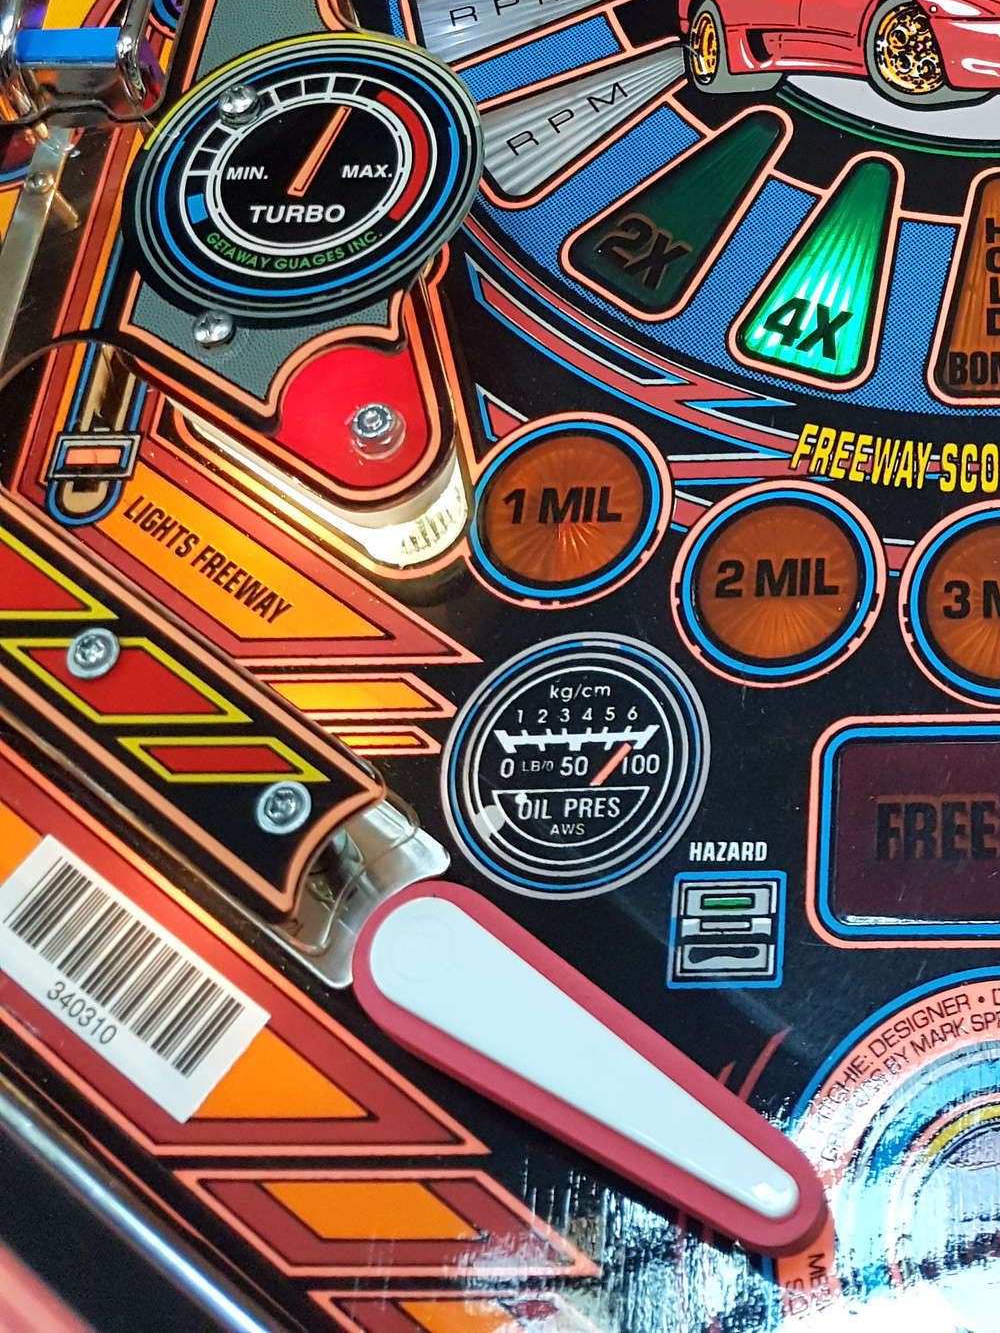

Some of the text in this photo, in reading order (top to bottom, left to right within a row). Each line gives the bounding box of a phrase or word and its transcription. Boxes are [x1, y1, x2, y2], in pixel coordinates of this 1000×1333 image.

[506, 82, 628, 156] RPM
[226, 167, 269, 180] MIN.
[342, 165, 393, 178] MAX.
[250, 205, 346, 224] TURBO
[206, 231, 383, 270] GETAWAY GUAGES INC.
[599, 214, 689, 290] 2X
[763, 297, 854, 360] 4X
[789, 423, 933, 490] FREEWAY
[503, 487, 623, 525] 1 MIL
[123, 495, 292, 624] LIGHTS FREEWAY
[714, 558, 839, 599] 2 MIL
[942, 580, 971, 620] 3
[549, 683, 611, 703] kg/cm
[537, 709, 548, 724] 2
[559, 709, 571, 723] 3
[581, 707, 593, 722] 4
[604, 706, 616, 721] 5
[627, 706, 639, 721] 6
[499, 758, 515, 779] 0
[559, 755, 589, 776] 50
[620, 754, 661, 775] 100
[517, 797, 621, 821] OIL PRES
[874, 793, 1000, 862] FREE
[550, 823, 585, 836] AWS
[688, 841, 768, 862] HAZARD
[47, 981, 117, 1045] 340310
[868, 994, 971, 1057] DESIGNER
[910, 1018, 969, 1056] MARK
